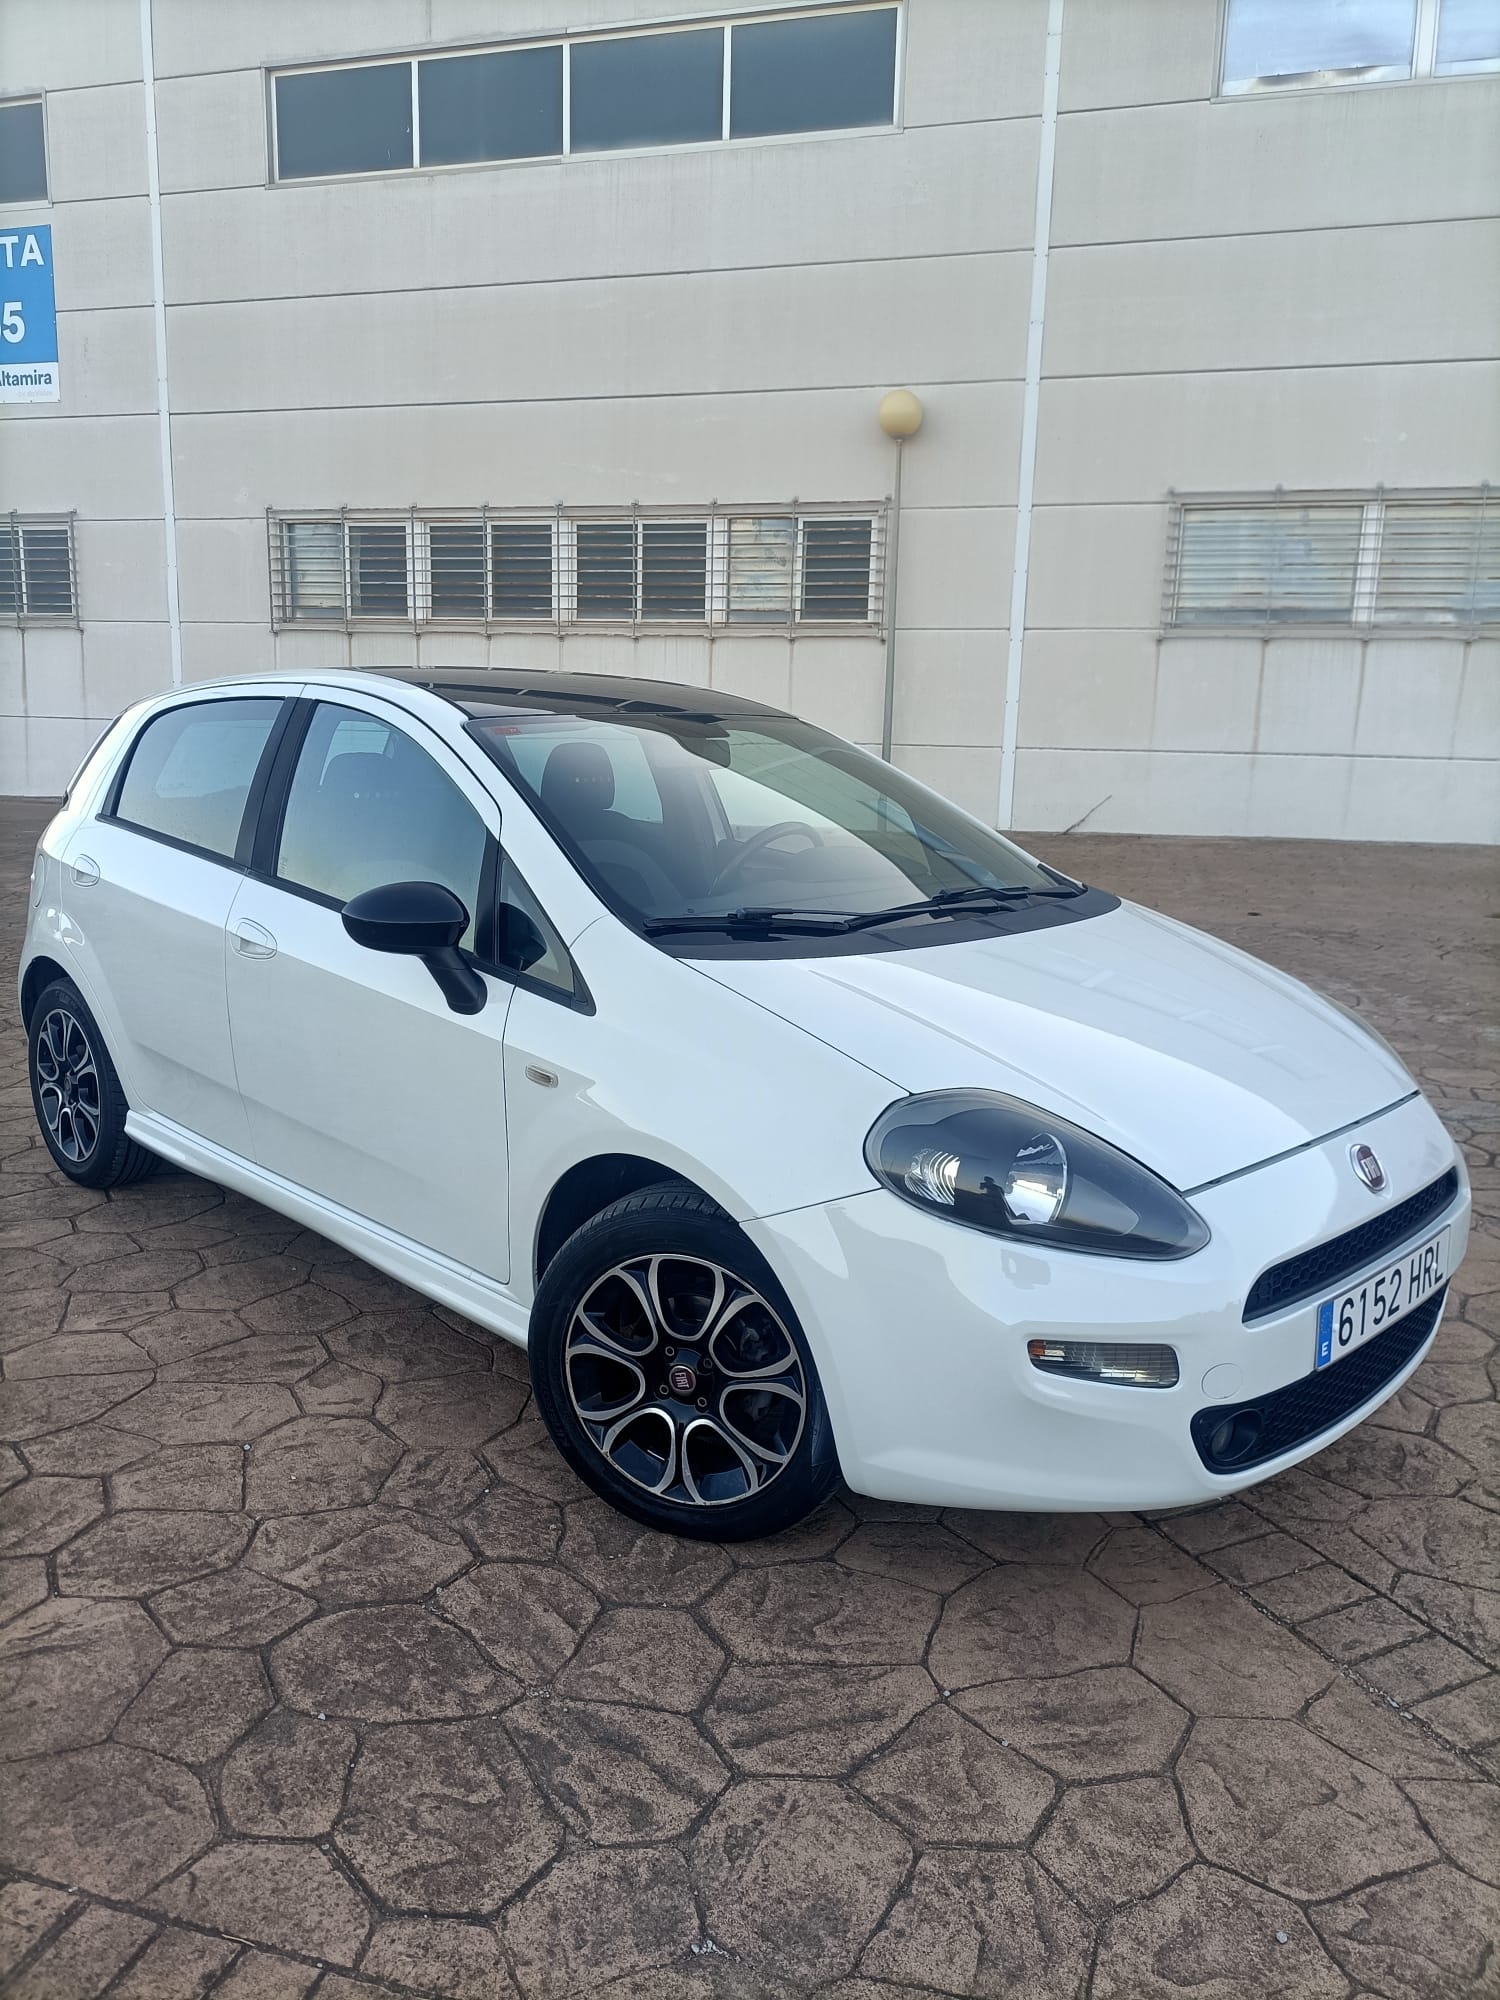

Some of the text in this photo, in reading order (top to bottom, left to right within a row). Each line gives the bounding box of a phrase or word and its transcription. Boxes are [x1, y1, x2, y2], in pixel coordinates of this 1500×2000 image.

[0, 301, 25, 343] 5
[0, 369, 52, 386] ltamira
[1338, 1241, 1443, 1346] 6152 HRL
[1321, 1341, 1329, 1357] E
[674, 1372, 690, 1388] FIAT
